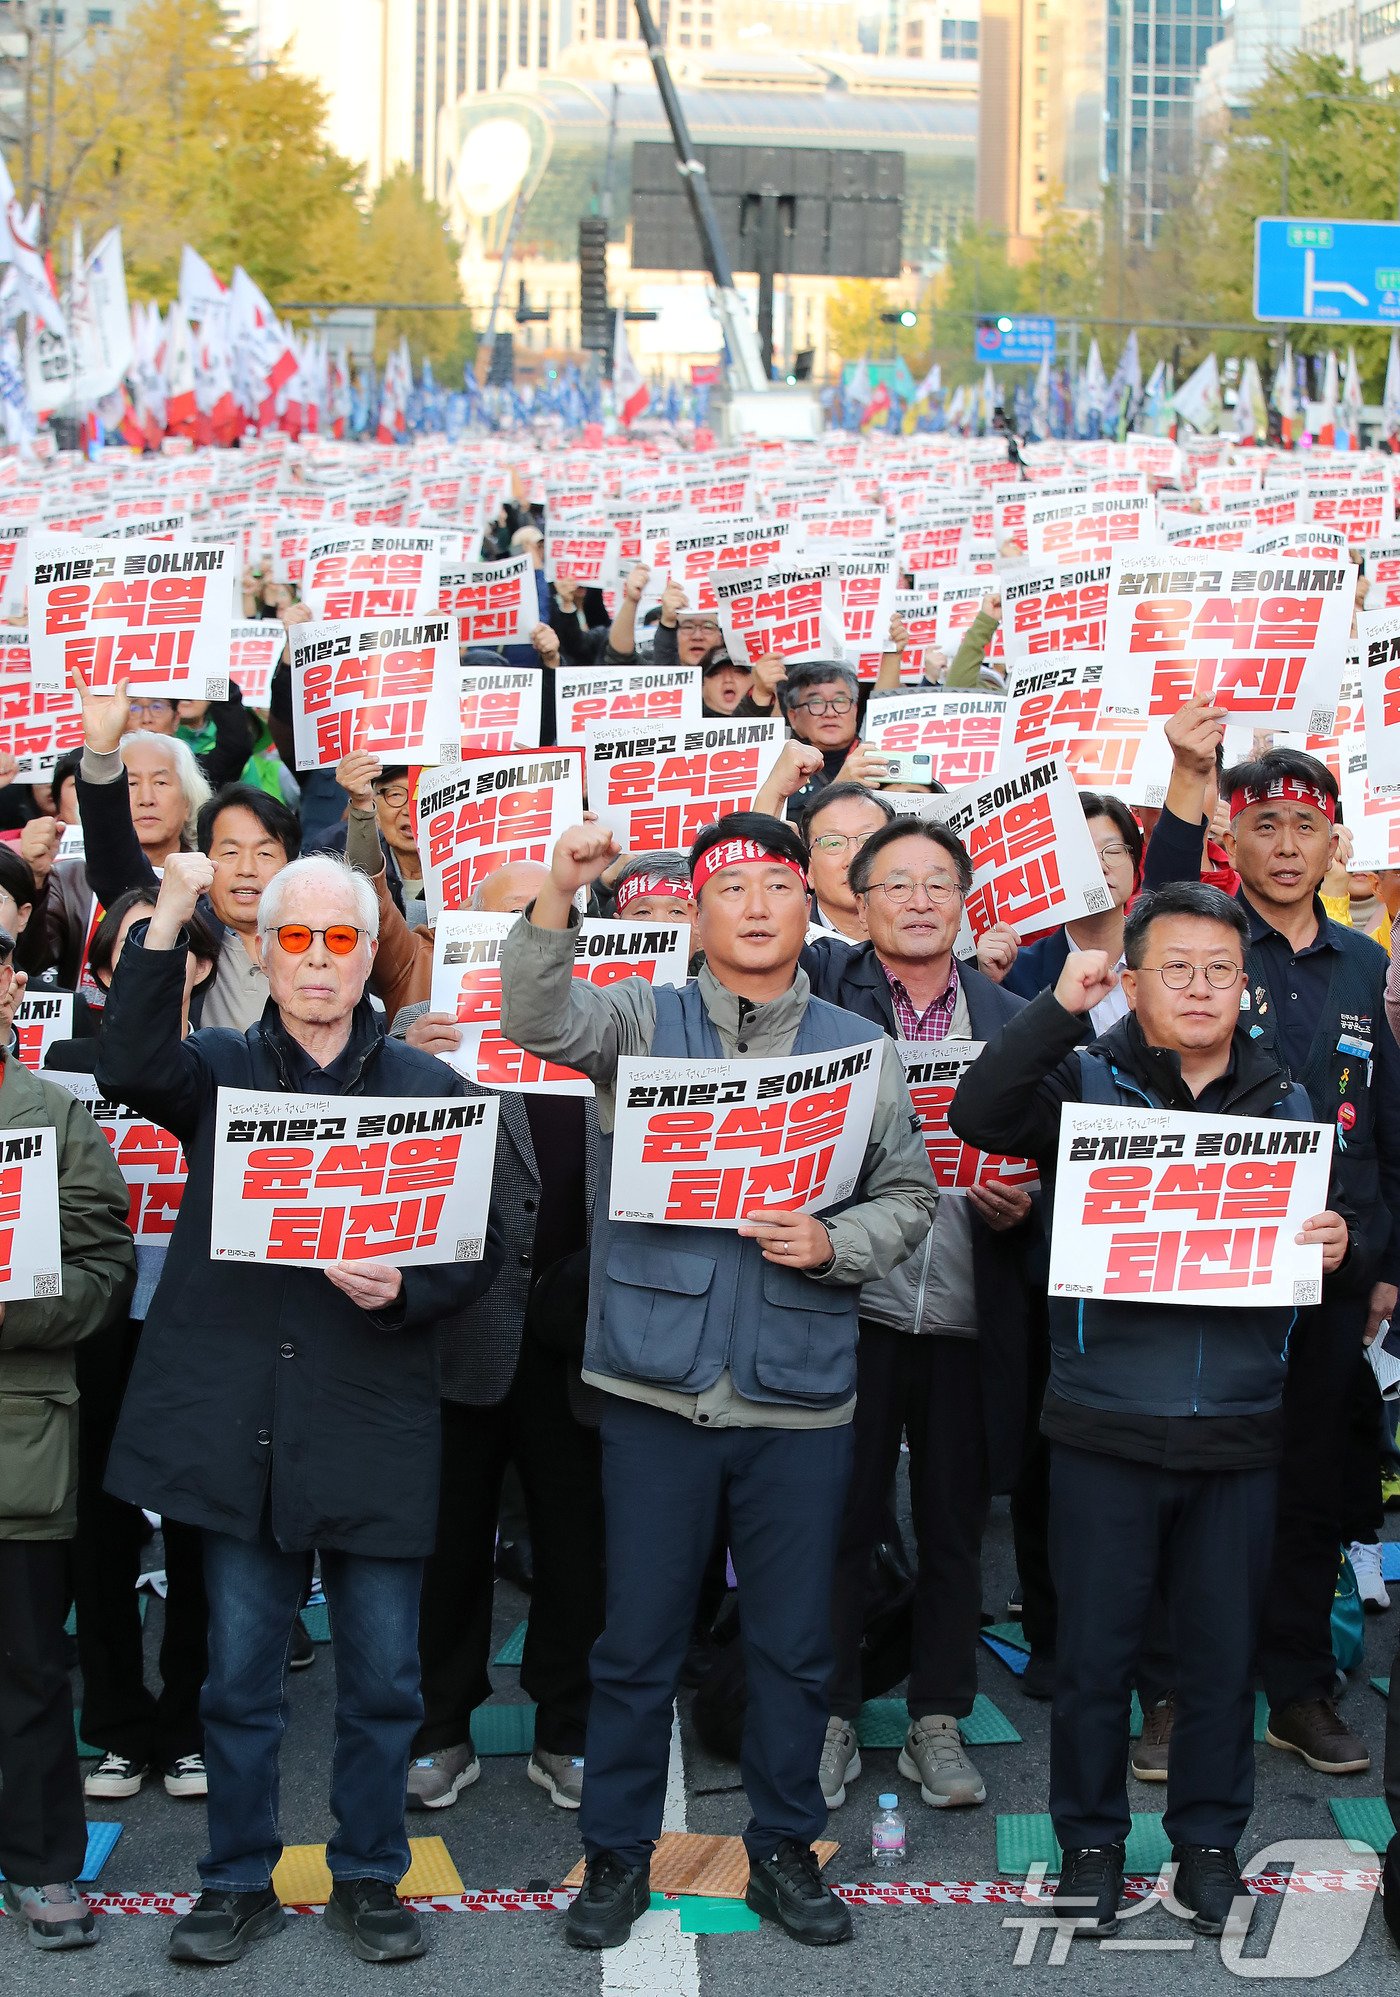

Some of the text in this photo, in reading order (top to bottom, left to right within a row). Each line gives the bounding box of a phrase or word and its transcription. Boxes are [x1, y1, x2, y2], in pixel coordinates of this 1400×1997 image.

[1032, 498, 1148, 524] 참지말고 몰아내자!
[1255, 502, 1295, 525] 석열
[1313, 497, 1383, 520] 윤석열
[310, 539, 364, 561] 참지말고
[371, 538, 433, 551] 몰아내자!
[551, 540, 606, 557] 윤석열
[676, 523, 789, 551] 참지말고 몰아내자!
[1042, 513, 1140, 553] 윤석열
[35, 550, 224, 585] 참지말고 몰아내자!
[312, 554, 423, 588] 윤석열
[472, 560, 528, 583] 몰아내자!
[685, 540, 781, 580] 윤석열
[717, 578, 762, 598] 참지말고
[1006, 578, 1054, 600] 참지말고
[1118, 570, 1345, 595] 참지말고 몰아내자!
[46, 576, 206, 635] 윤석열
[323, 588, 417, 620] 퇴진!
[731, 581, 822, 630] 윤석열
[1014, 583, 1109, 633] 윤석열
[744, 616, 821, 663] 퇴진!
[1028, 620, 1106, 654] 퇴진
[1129, 597, 1324, 653] 윤석열
[65, 630, 195, 689] 퇴진!
[295, 636, 351, 669] 참지말고
[359, 622, 449, 651] 몰아내자!
[303, 648, 435, 715] 윤석열
[461, 673, 533, 692] 몰아내자!
[562, 671, 694, 698] 참지말고 몰아내자!
[1013, 668, 1076, 698] 참지말고
[1149, 657, 1306, 717] 퇴진!
[571, 689, 683, 732] 윤석열
[872, 701, 1007, 726] 참지말고 몰아내자
[317, 700, 427, 765] 퇴진!
[594, 723, 774, 761] 참지말고 몰아내자!
[881, 717, 1002, 752] 윤석열
[420, 778, 470, 819] 참지말고
[476, 758, 570, 794] 몰아내자!
[608, 747, 760, 805] 윤석열
[977, 760, 1058, 817] 몰아내자!
[429, 787, 553, 868] 윤석열
[960, 793, 1058, 870] 석열
[705, 839, 745, 875] 단결
[618, 877, 640, 908] 단결
[964, 850, 1067, 949] 퇴진!
[443, 939, 505, 965] 참지
[627, 1048, 873, 1108] 참지말고 몰아내자!
[628, 1065, 732, 1083] 전태일열사 정신계승!
[226, 1104, 486, 1143] 참지말고 몰아내자!
[228, 1101, 331, 1115] 전태일열사 정신계승!
[641, 1082, 853, 1163] 윤석열
[1072, 1116, 1171, 1132] 전태일열사 정신계승!
[1069, 1131, 1321, 1161] 참지말고 몰아내자!
[242, 1134, 463, 1199] 윤석열
[664, 1144, 836, 1220] 퇴진!
[1081, 1161, 1297, 1225] 윤석열
[266, 1194, 446, 1260] 퇴진!
[625, 1211, 655, 1219] 민주노총
[227, 1249, 256, 1258] 민주노총
[1103, 1226, 1279, 1294] 퇴진!
[1065, 1284, 1094, 1293] 민주노총
[460, 1893, 554, 1904] DANGER!
[838, 1887, 931, 1897] DANGER!
[1243, 1877, 1304, 1887] NGER!
[84, 1896, 175, 1907] DANGER!
